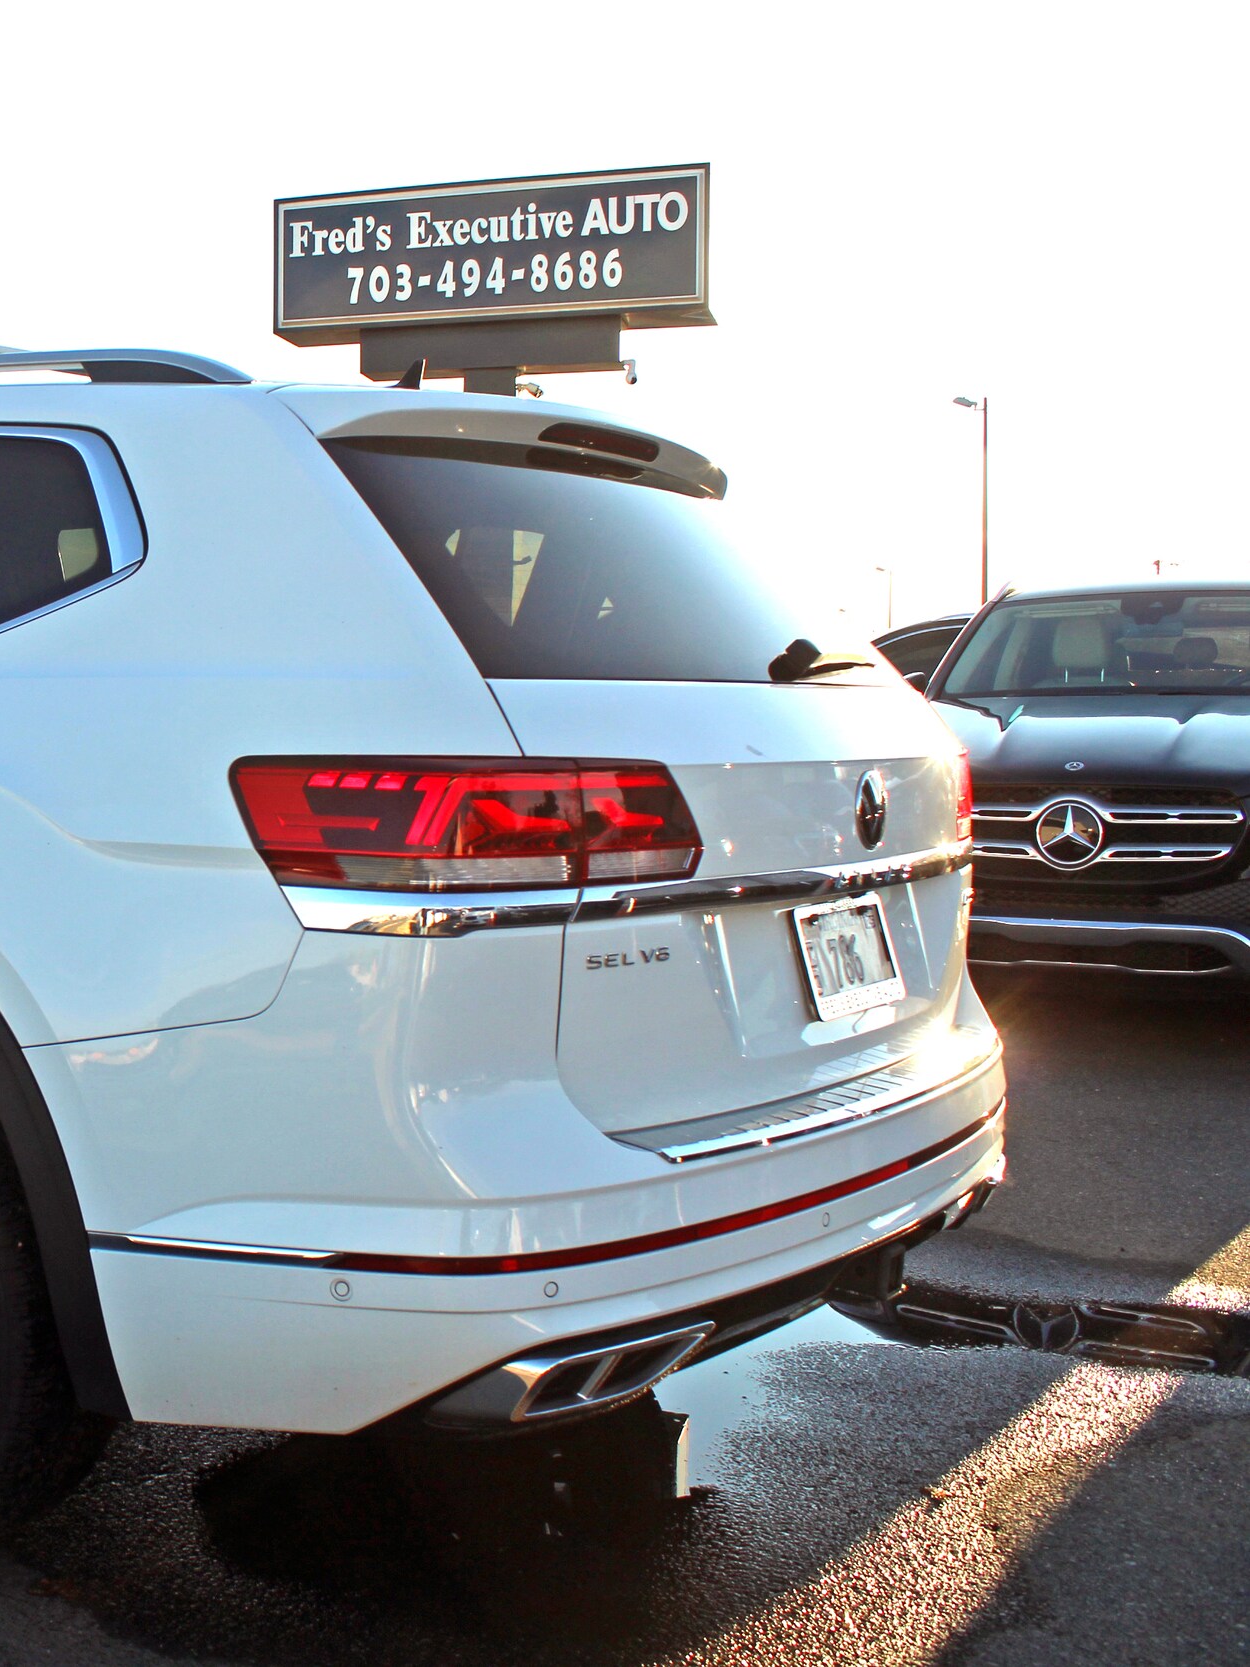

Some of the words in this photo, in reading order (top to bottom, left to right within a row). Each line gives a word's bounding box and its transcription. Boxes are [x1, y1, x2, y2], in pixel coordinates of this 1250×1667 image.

[289, 216, 391, 257] Fred's
[406, 202, 573, 249] Executive
[581, 191, 688, 236] AUTO
[347, 249, 623, 304] 703-494-8686
[586, 951, 635, 970] SEL
[639, 946, 670, 964] V6
